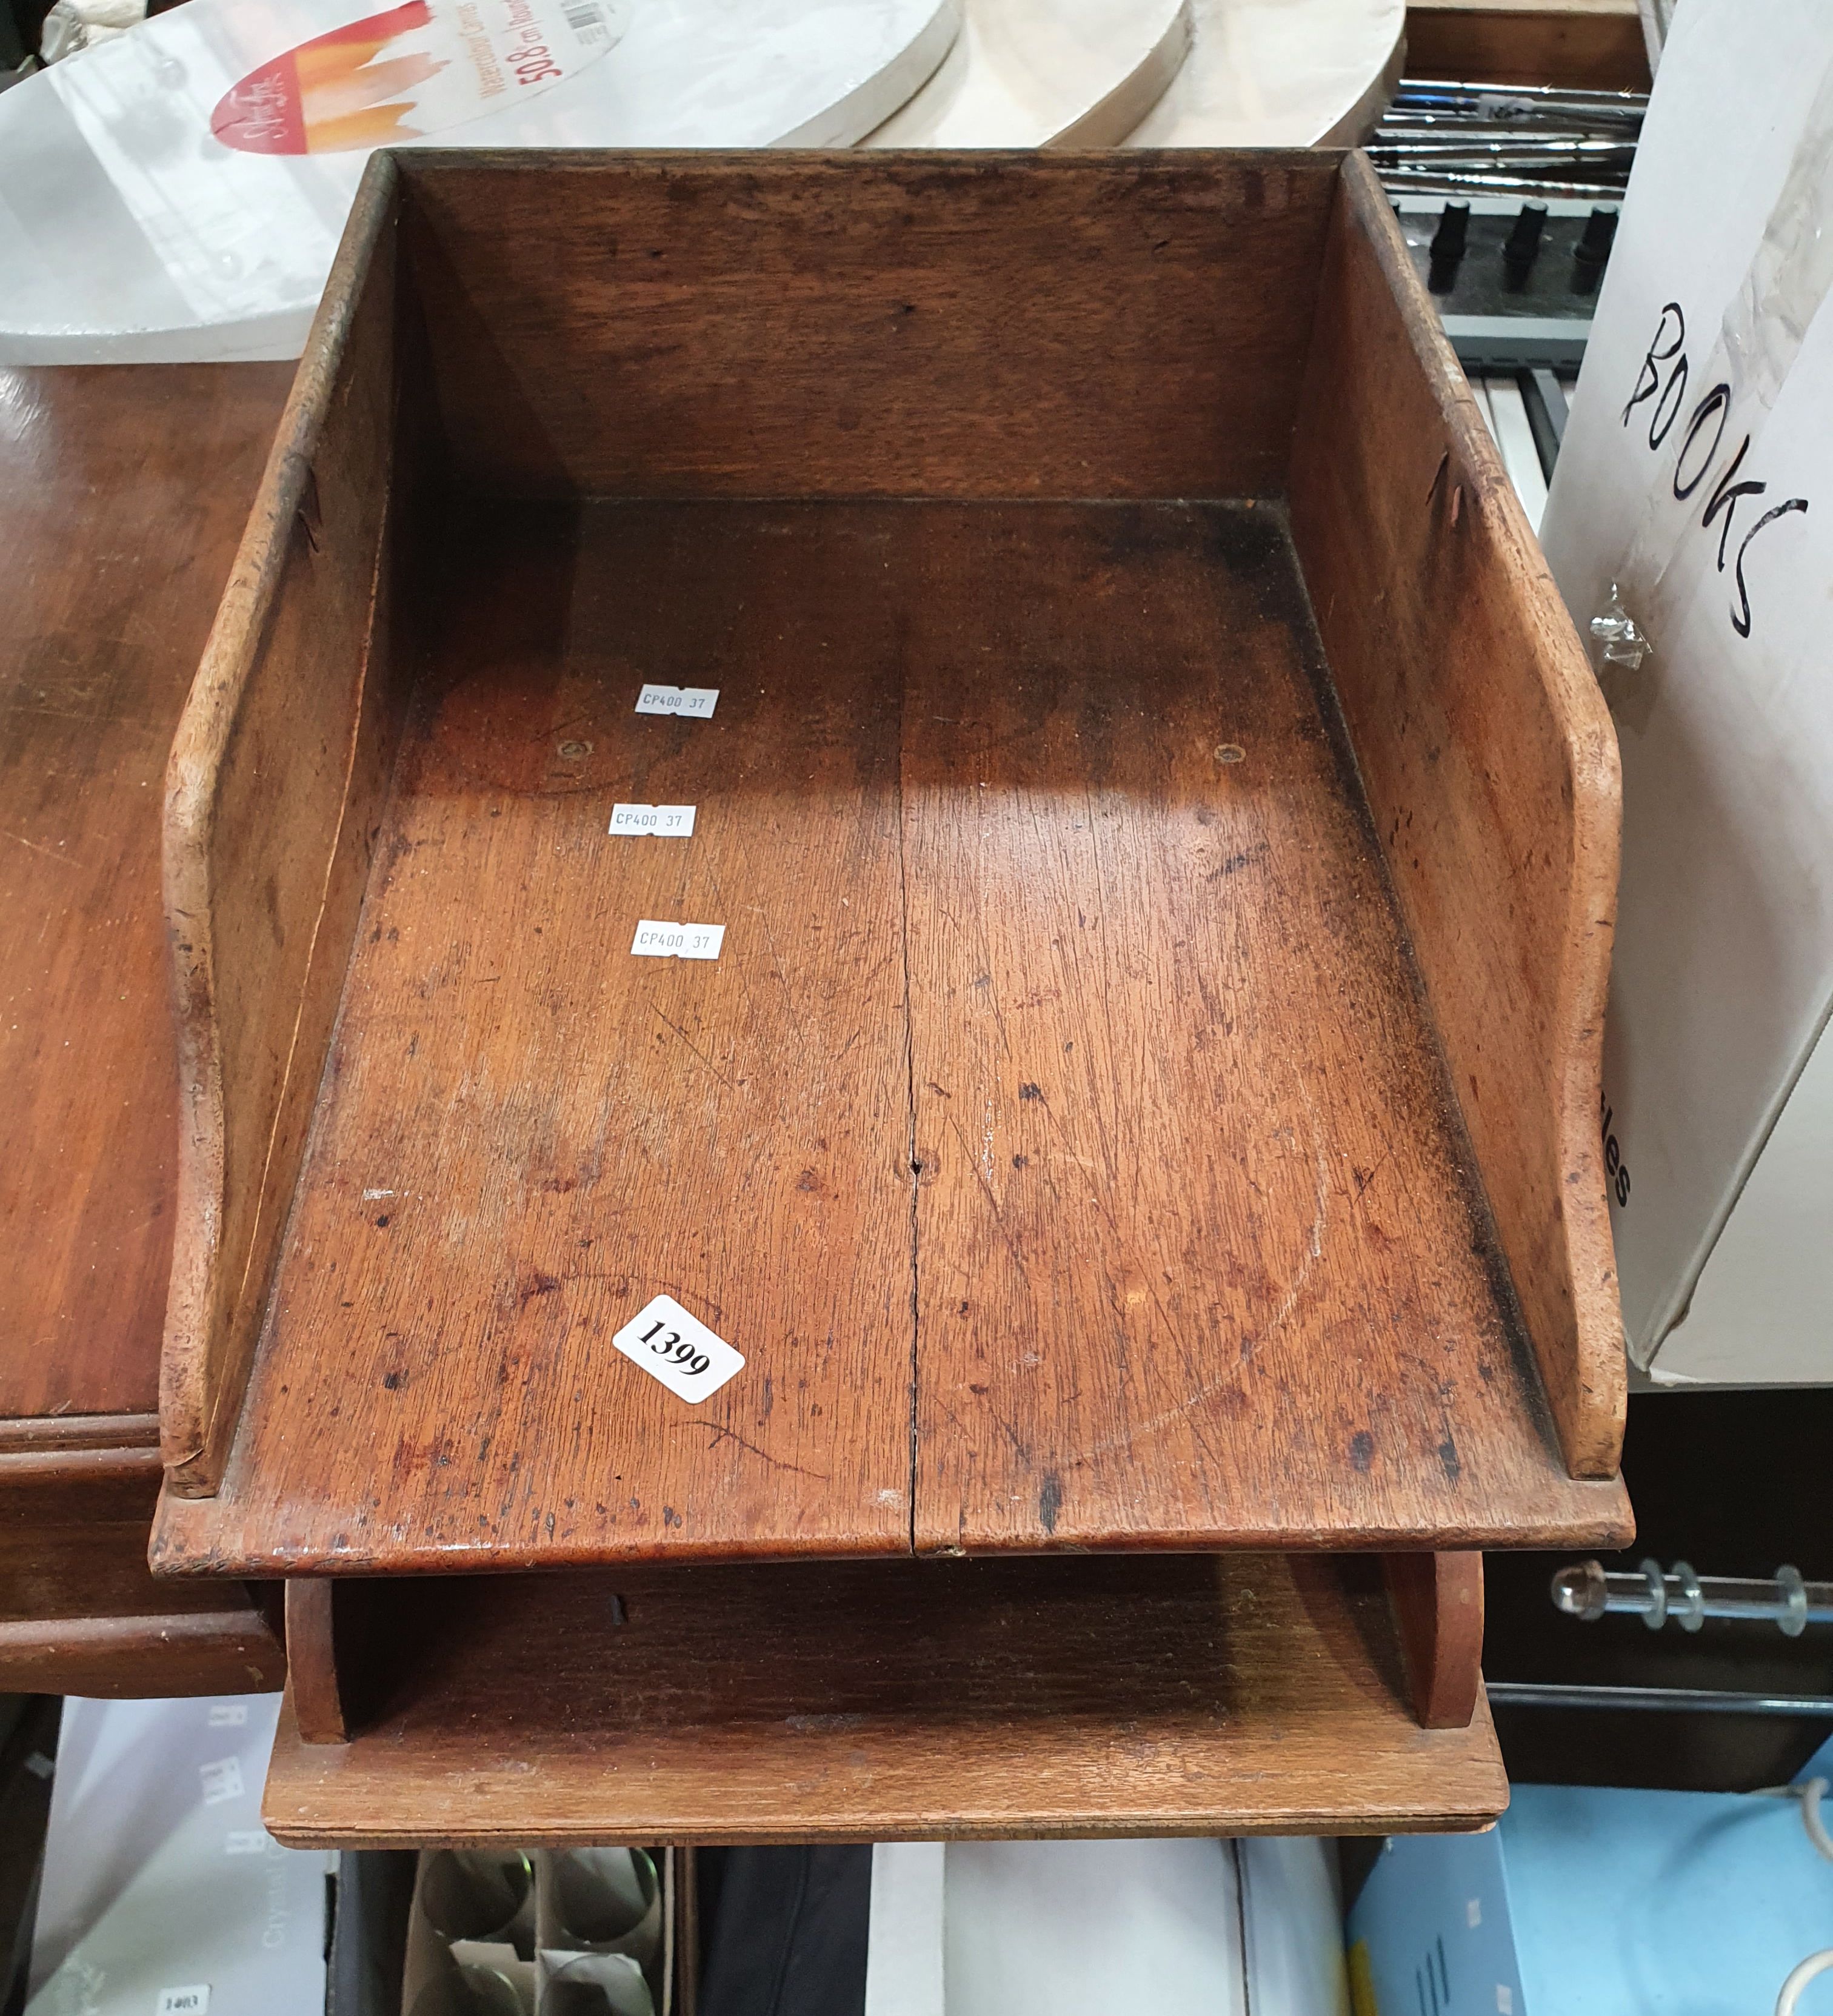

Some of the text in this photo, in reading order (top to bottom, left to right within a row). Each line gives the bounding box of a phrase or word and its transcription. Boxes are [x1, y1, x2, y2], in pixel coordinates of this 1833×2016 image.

[521, 27, 543, 43] cm
[507, 45, 563, 85] 50.8
[1620, 302, 1809, 638] BOOKS
[643, 693, 706, 709] CP400 37
[616, 812, 683, 827] CP400 37
[640, 931, 710, 949] CP400 37
[636, 1319, 710, 1376] 1399
